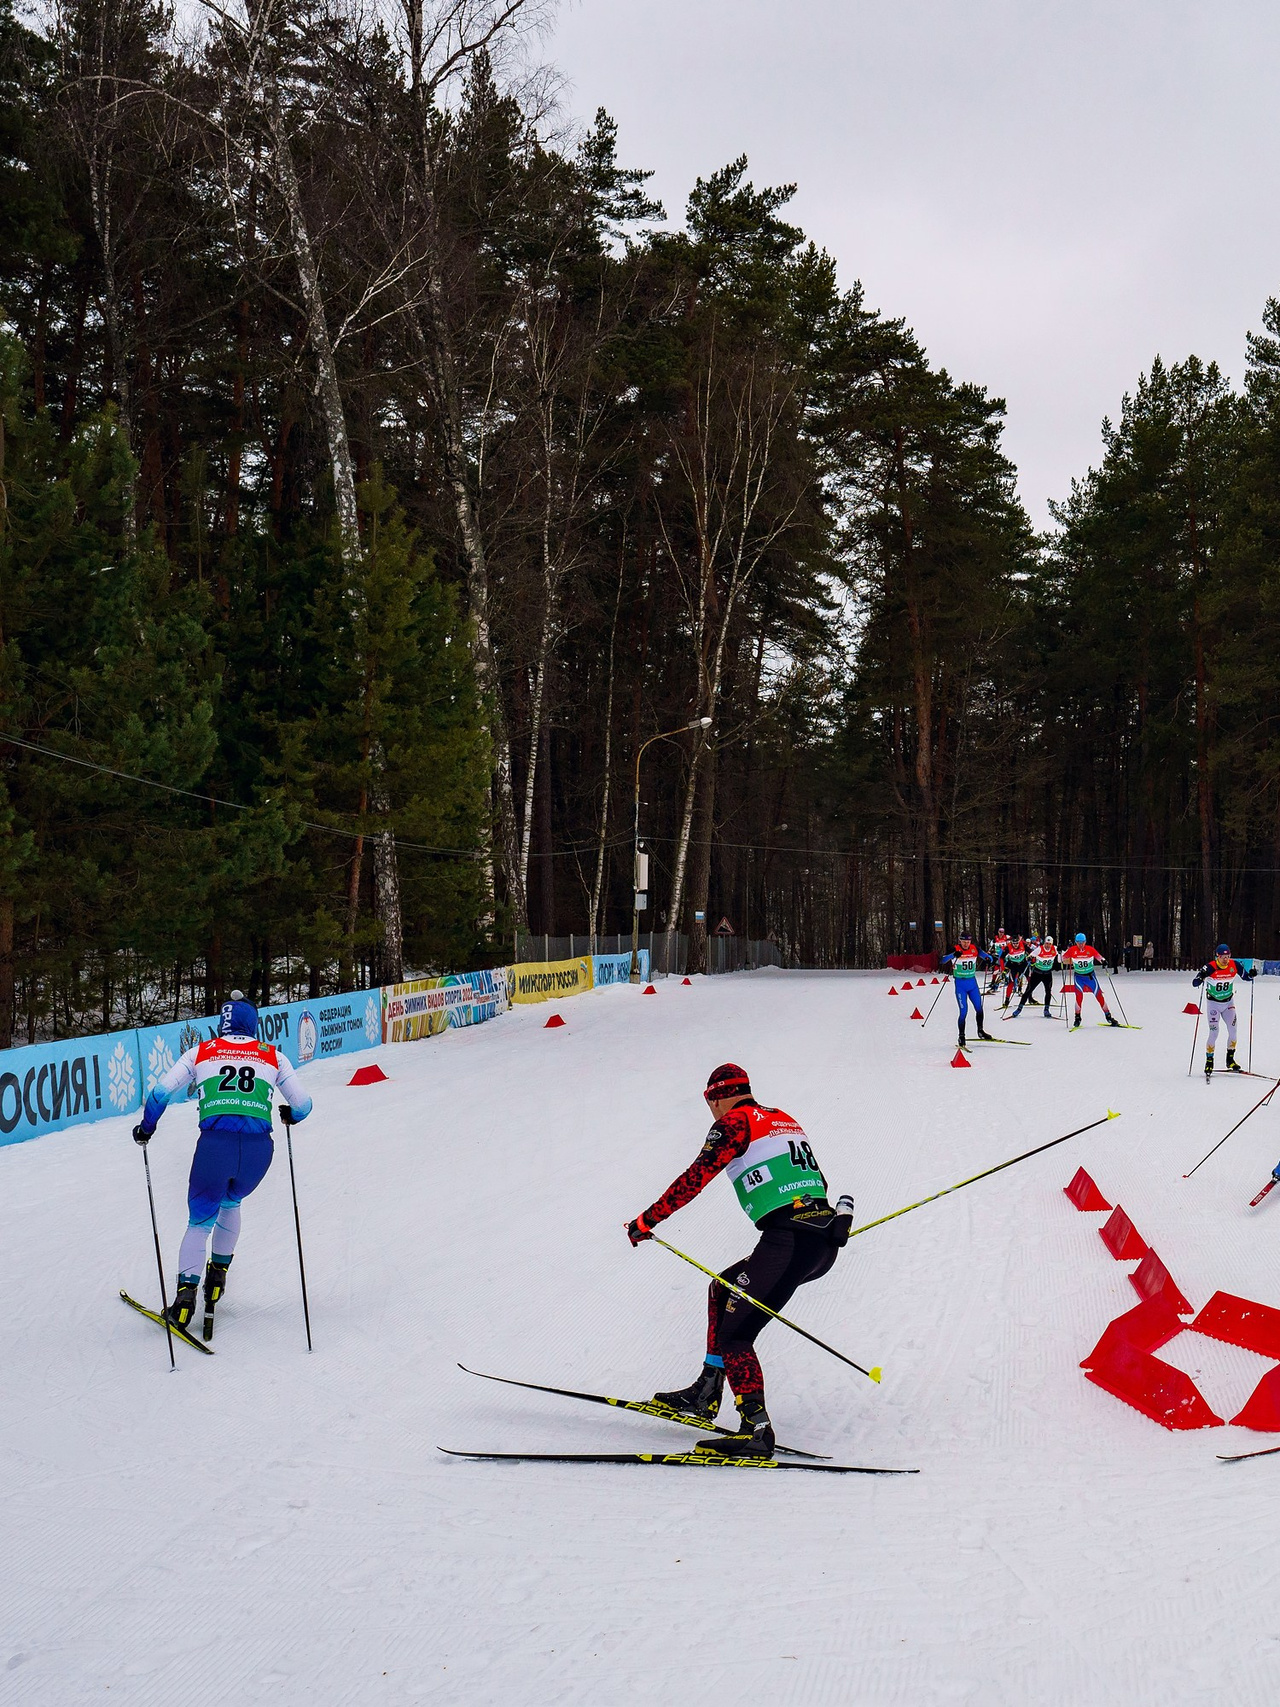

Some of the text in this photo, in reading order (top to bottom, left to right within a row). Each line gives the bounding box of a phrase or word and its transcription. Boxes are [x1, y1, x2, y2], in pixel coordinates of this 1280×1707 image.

[961, 960, 974, 971] 50
[1077, 960, 1089, 968] 36
[1215, 981, 1230, 992] 68
[387, 1001, 405, 1020] ДЕНЬ
[405, 993, 428, 1014] ЗИМНИХ
[428, 989, 445, 1010] ВИДОВ
[320, 1005, 351, 1022] ФЕДЕРАЦИЯ
[320, 1017, 363, 1037] ЛЫЖНЫХ ГОНОК
[216, 1048, 259, 1056] ФЕДЕРАЦИЯ
[321, 1037, 343, 1053] РОССИИ
[218, 1065, 256, 1093] 28
[787, 1140, 820, 1172] 48
[746, 1169, 764, 1187] 48
[778, 1178, 815, 1194] КАЛУЖСКОЙ
[625, 1401, 716, 1431] FISCHER
[663, 1454, 779, 1469] FISCHER
